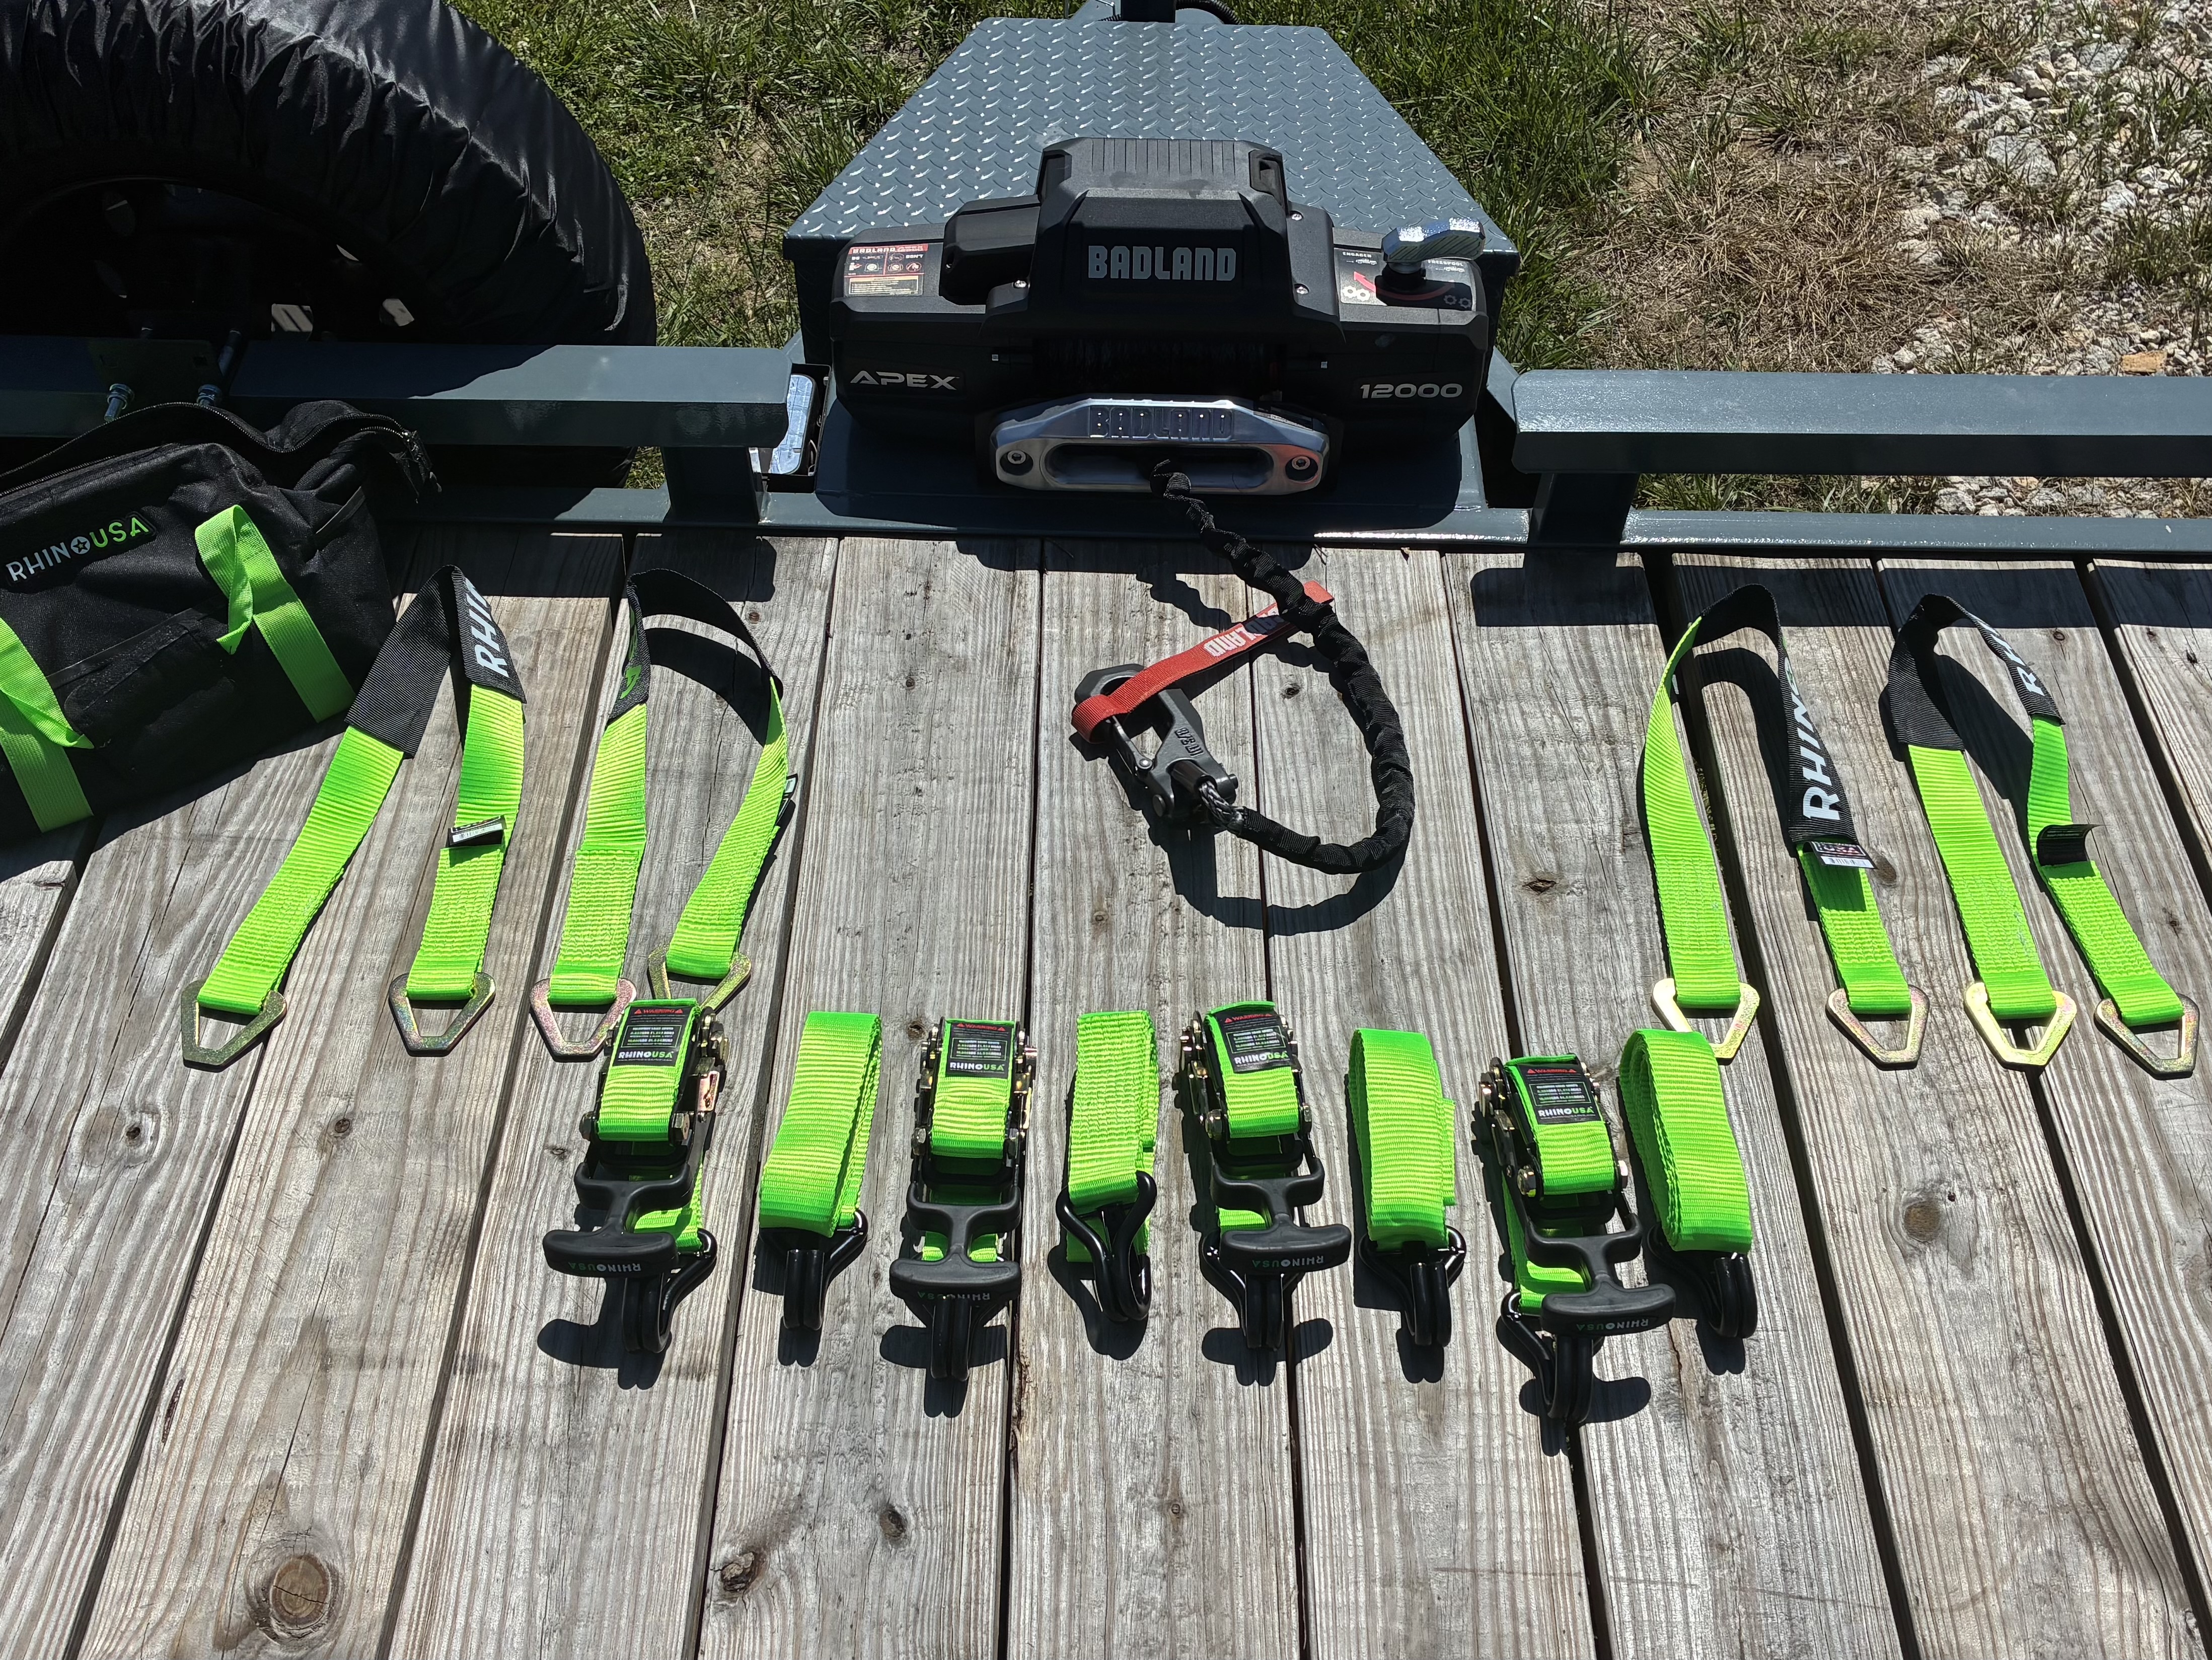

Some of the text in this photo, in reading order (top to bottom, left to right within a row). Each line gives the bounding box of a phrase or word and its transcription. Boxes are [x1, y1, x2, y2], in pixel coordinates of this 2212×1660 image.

[1088, 245, 1236, 281] BADLAND
[850, 370, 957, 390] APEX
[1360, 383, 1463, 398] 12000
[1088, 405, 1232, 440] BADLAND
